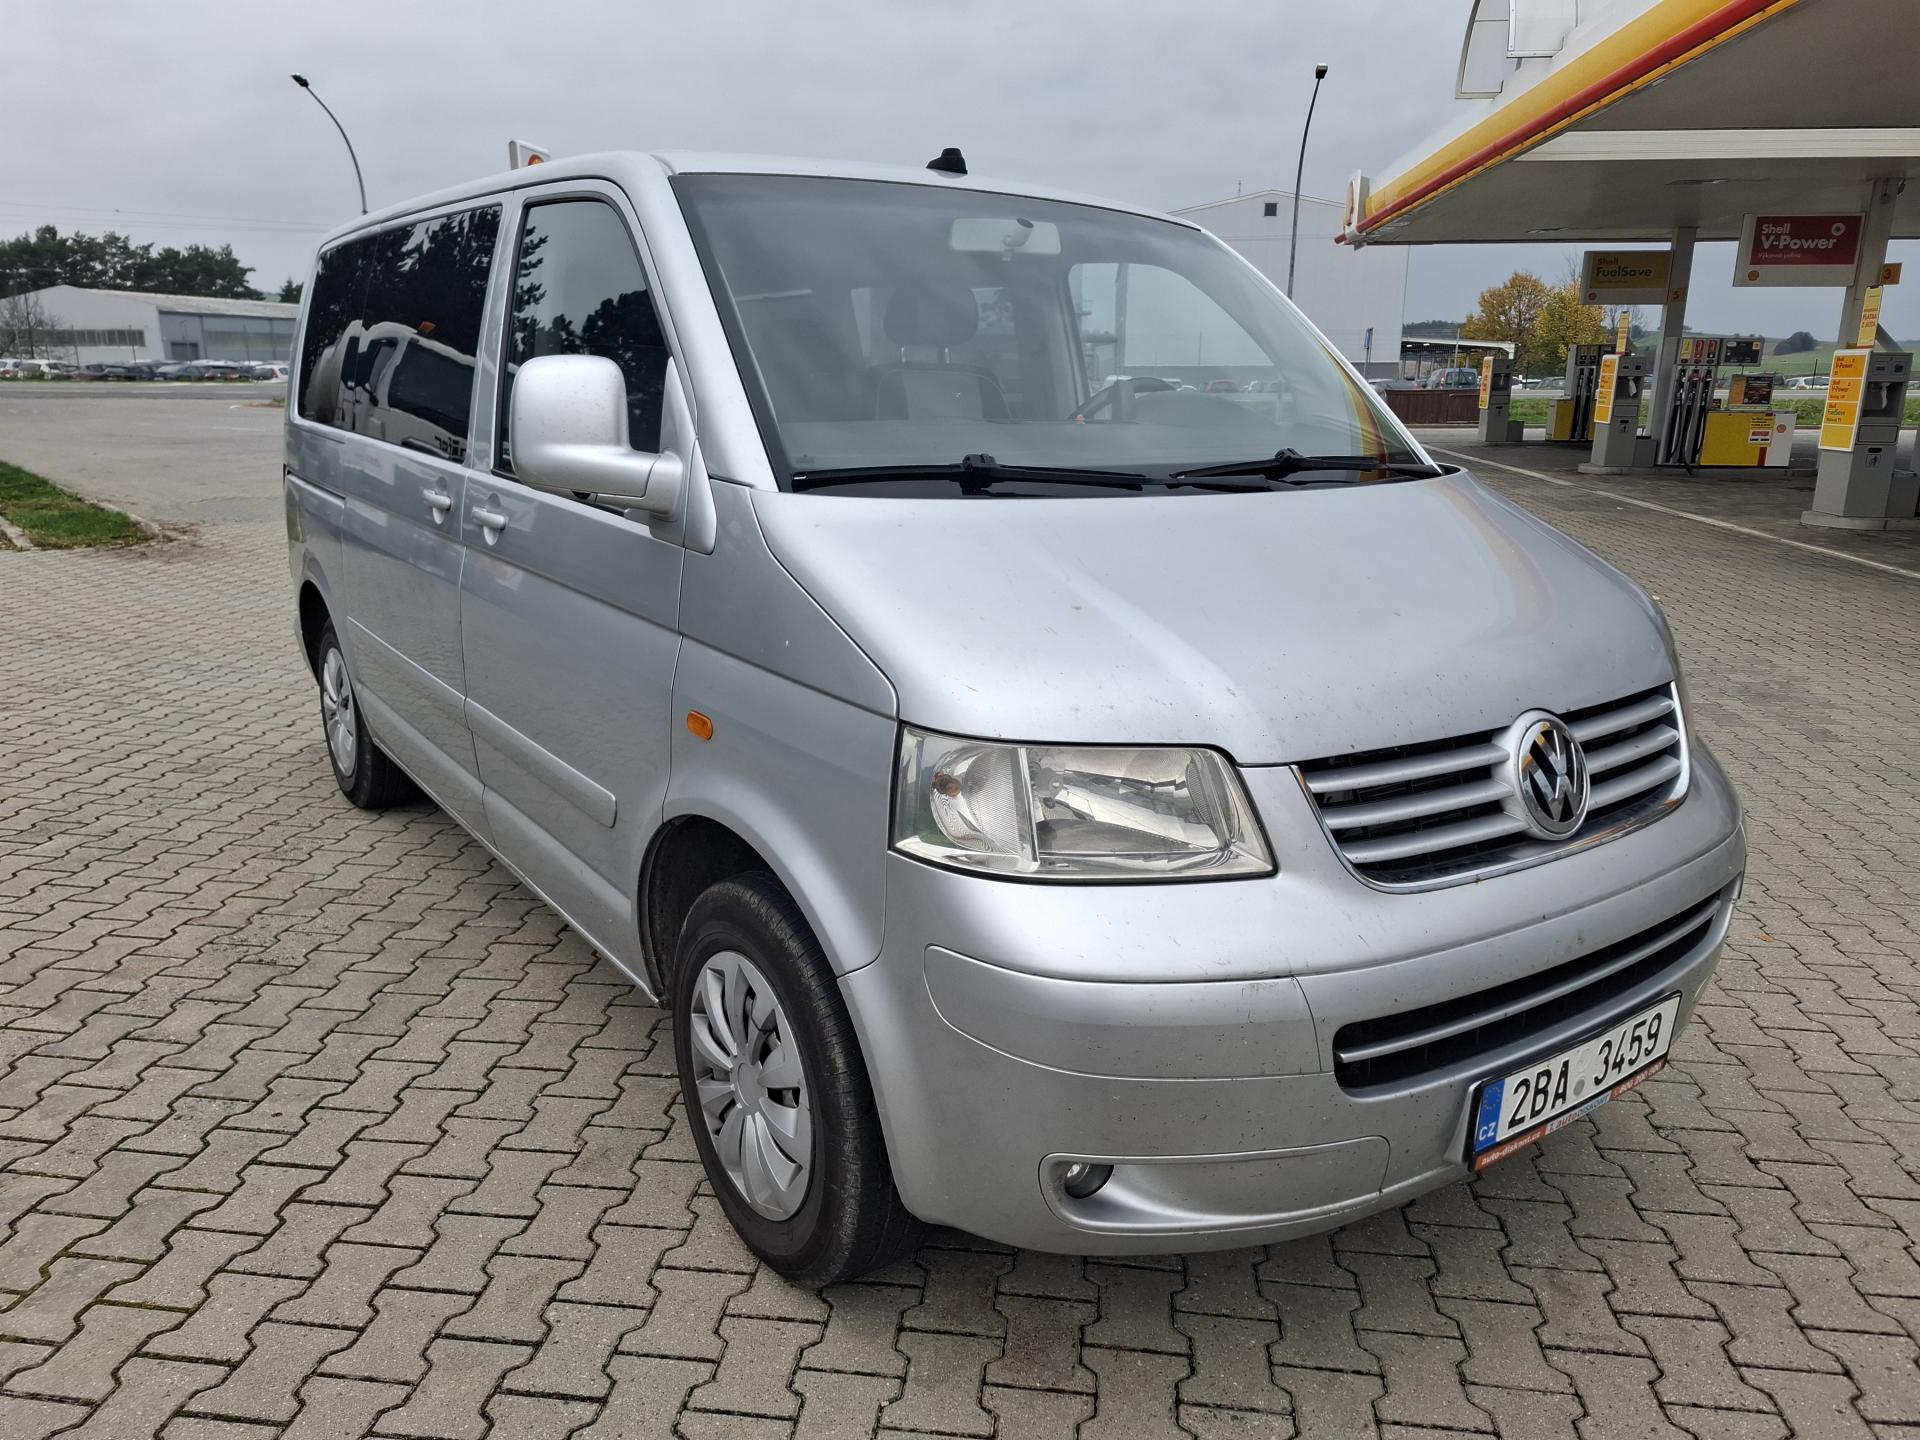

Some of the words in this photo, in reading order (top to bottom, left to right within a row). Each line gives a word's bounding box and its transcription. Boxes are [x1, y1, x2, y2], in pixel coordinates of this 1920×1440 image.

[1761, 223, 1791, 234] Shell
[1761, 235, 1837, 249] V-Power
[1595, 265, 1652, 277] FuelSave
[1883, 268, 1892, 280] 3
[1507, 1059, 1570, 1130] 2BA
[1593, 1012, 1662, 1086] 3459
[1479, 1121, 1497, 1141] CZ
[1481, 1131, 1541, 1166] auto-diskont.cz
